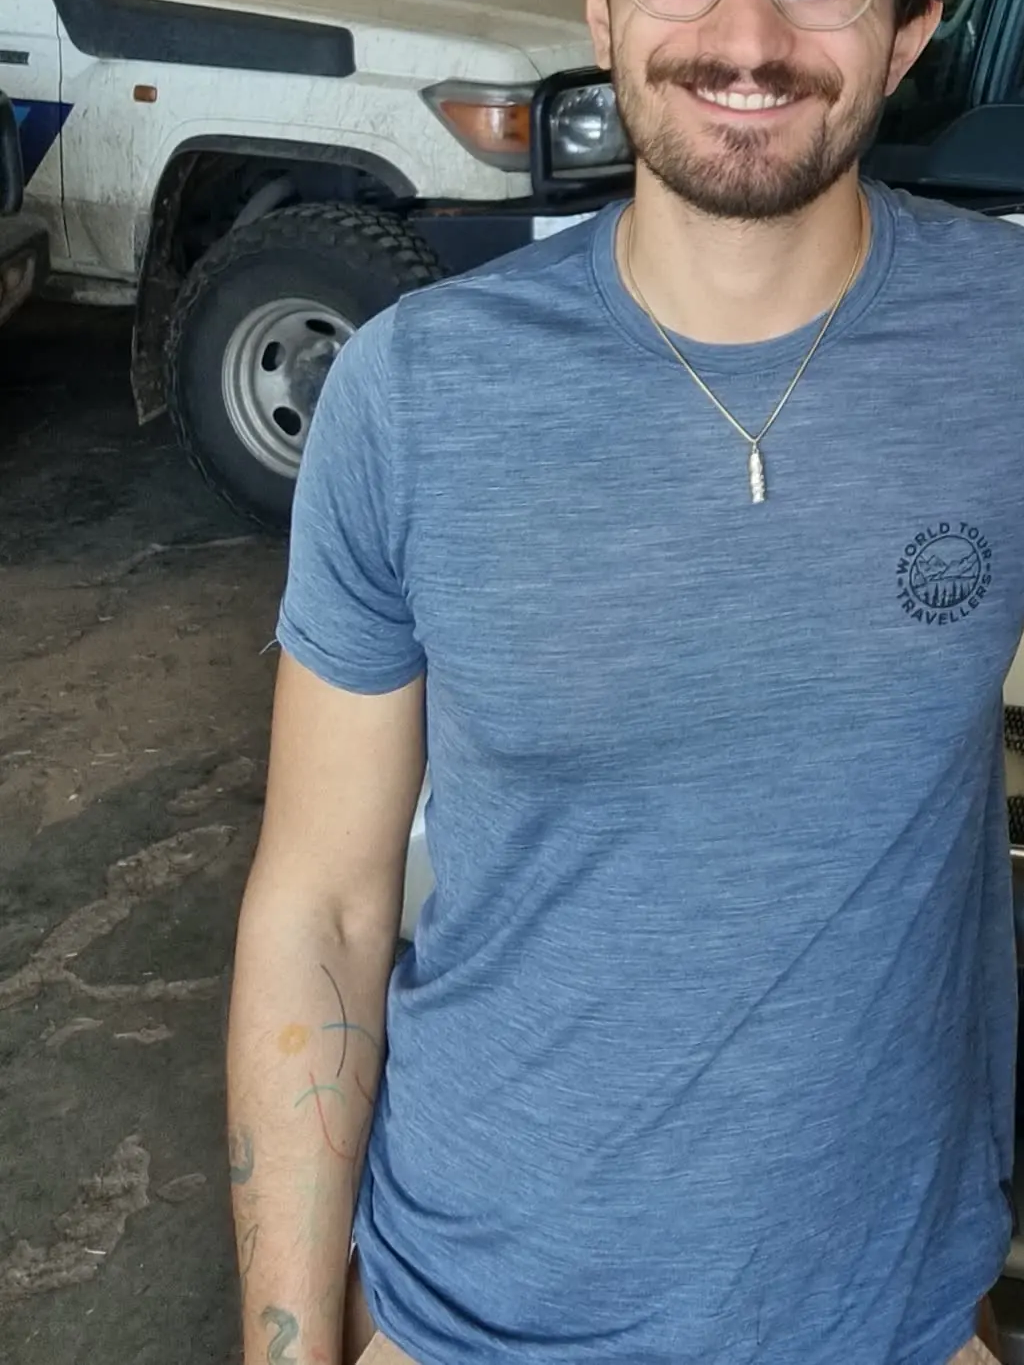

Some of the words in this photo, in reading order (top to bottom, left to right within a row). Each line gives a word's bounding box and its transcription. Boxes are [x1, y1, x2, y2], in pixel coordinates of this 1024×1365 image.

[896, 522, 950, 574] WORLD
[959, 522, 992, 560] TOUR
[897, 574, 992, 626] TRAVELLERS
